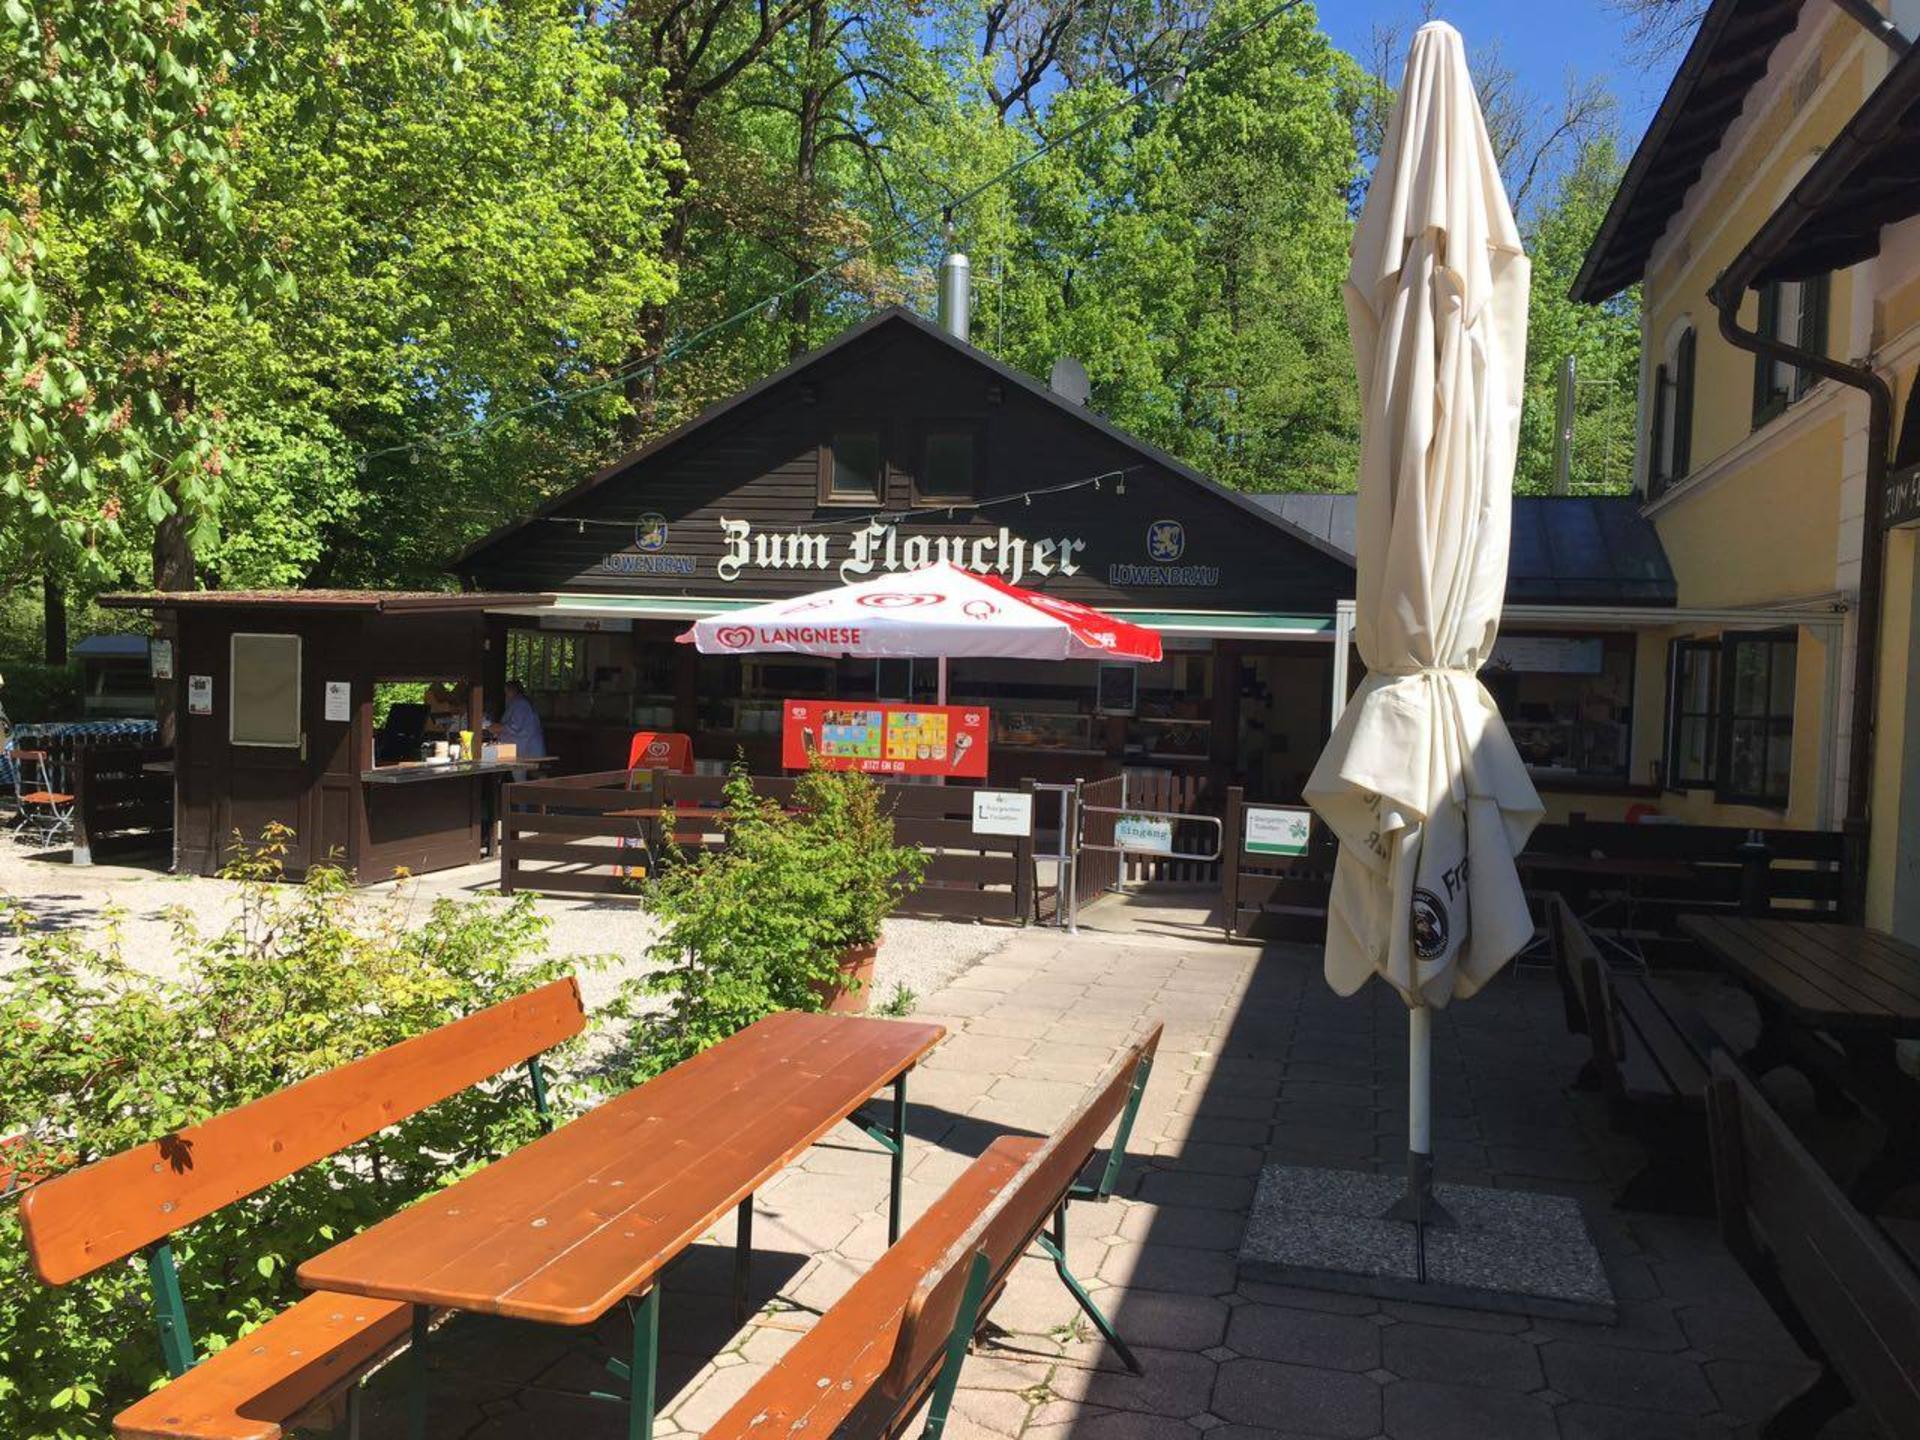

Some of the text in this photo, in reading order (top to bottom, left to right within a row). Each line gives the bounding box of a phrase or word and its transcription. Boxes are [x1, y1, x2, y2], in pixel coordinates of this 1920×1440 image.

[717, 515, 1086, 586] Zum Flaucher
[760, 627, 861, 645] LANGNESE
[1119, 825, 1168, 841] Eingang
